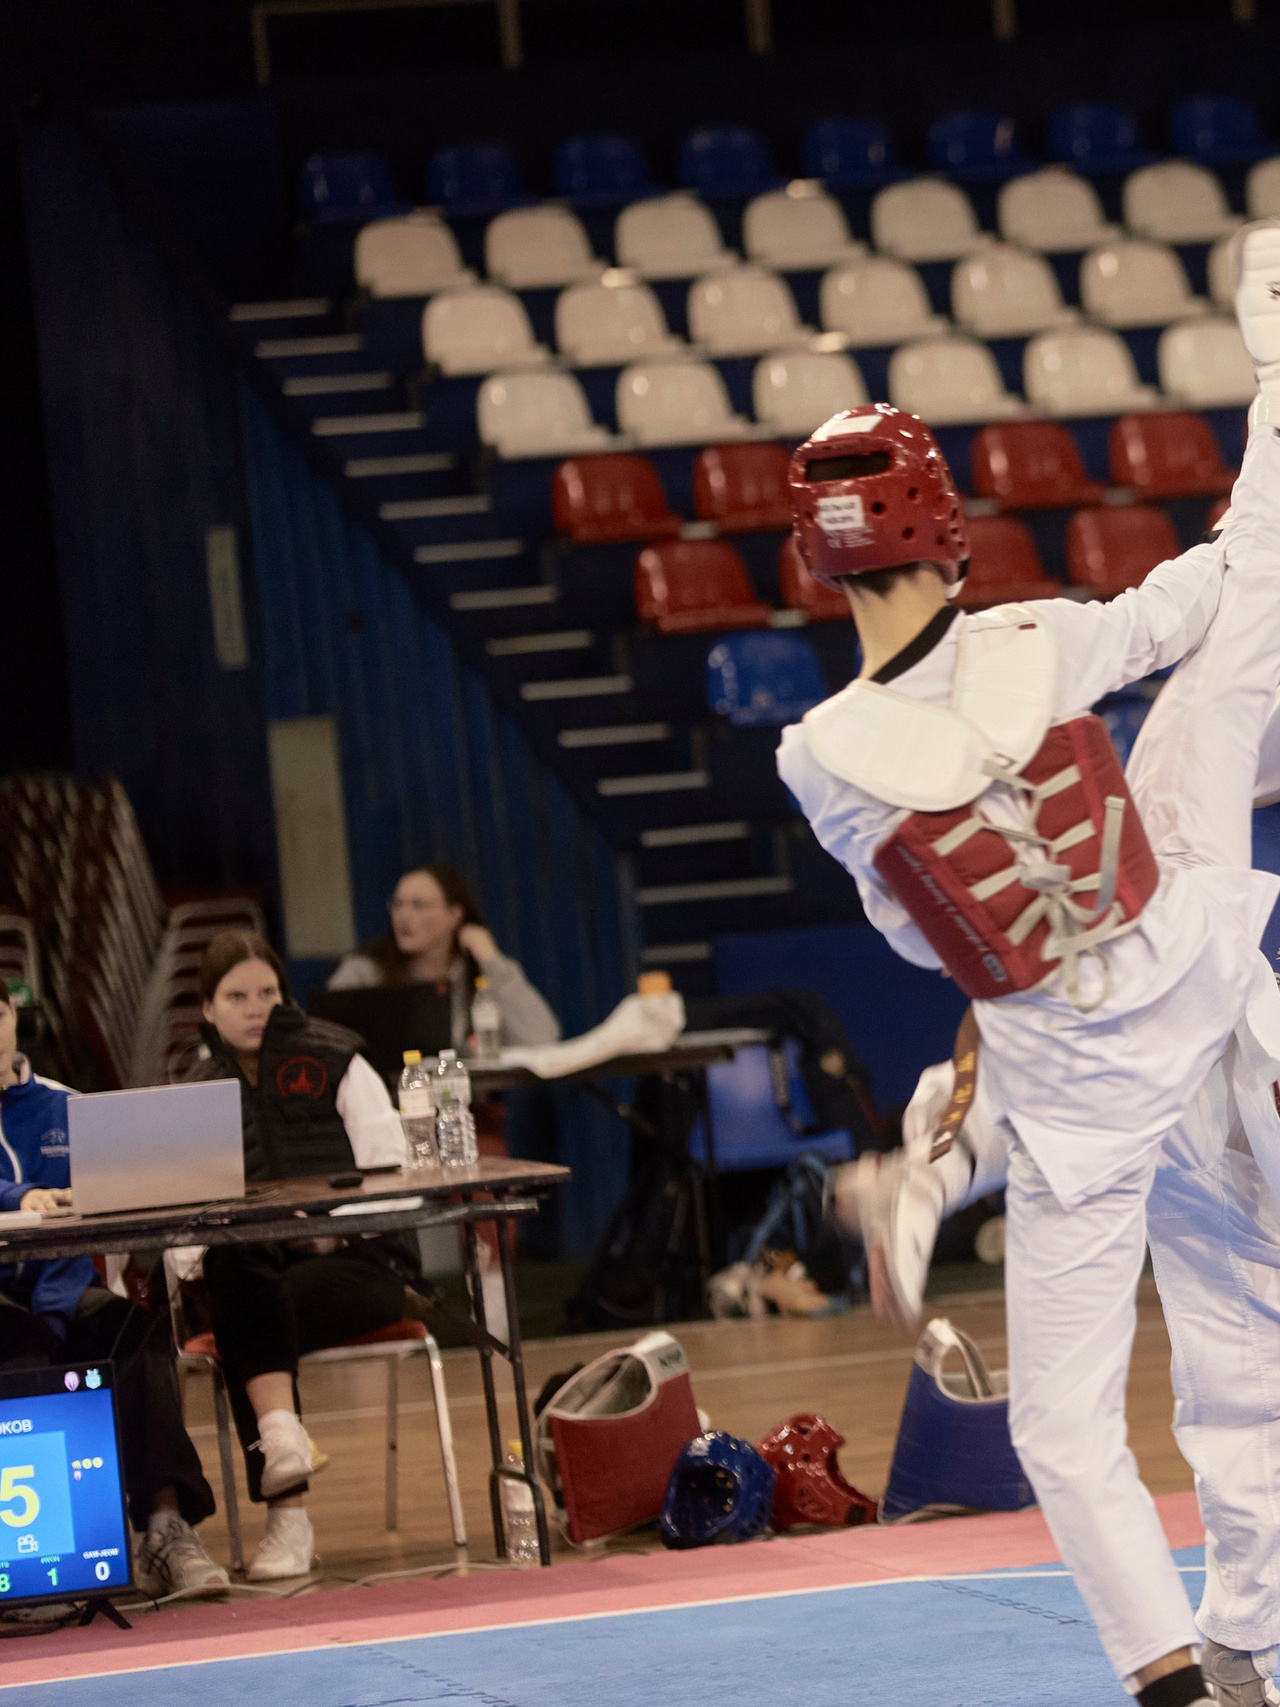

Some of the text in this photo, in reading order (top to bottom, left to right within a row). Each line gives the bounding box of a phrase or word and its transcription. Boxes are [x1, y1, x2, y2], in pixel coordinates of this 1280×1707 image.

[0, 1419, 33, 1435] КОВ
[0, 1464, 40, 1528] 5
[46, 1567, 58, 1587] 1
[95, 1561, 110, 1581] 0
